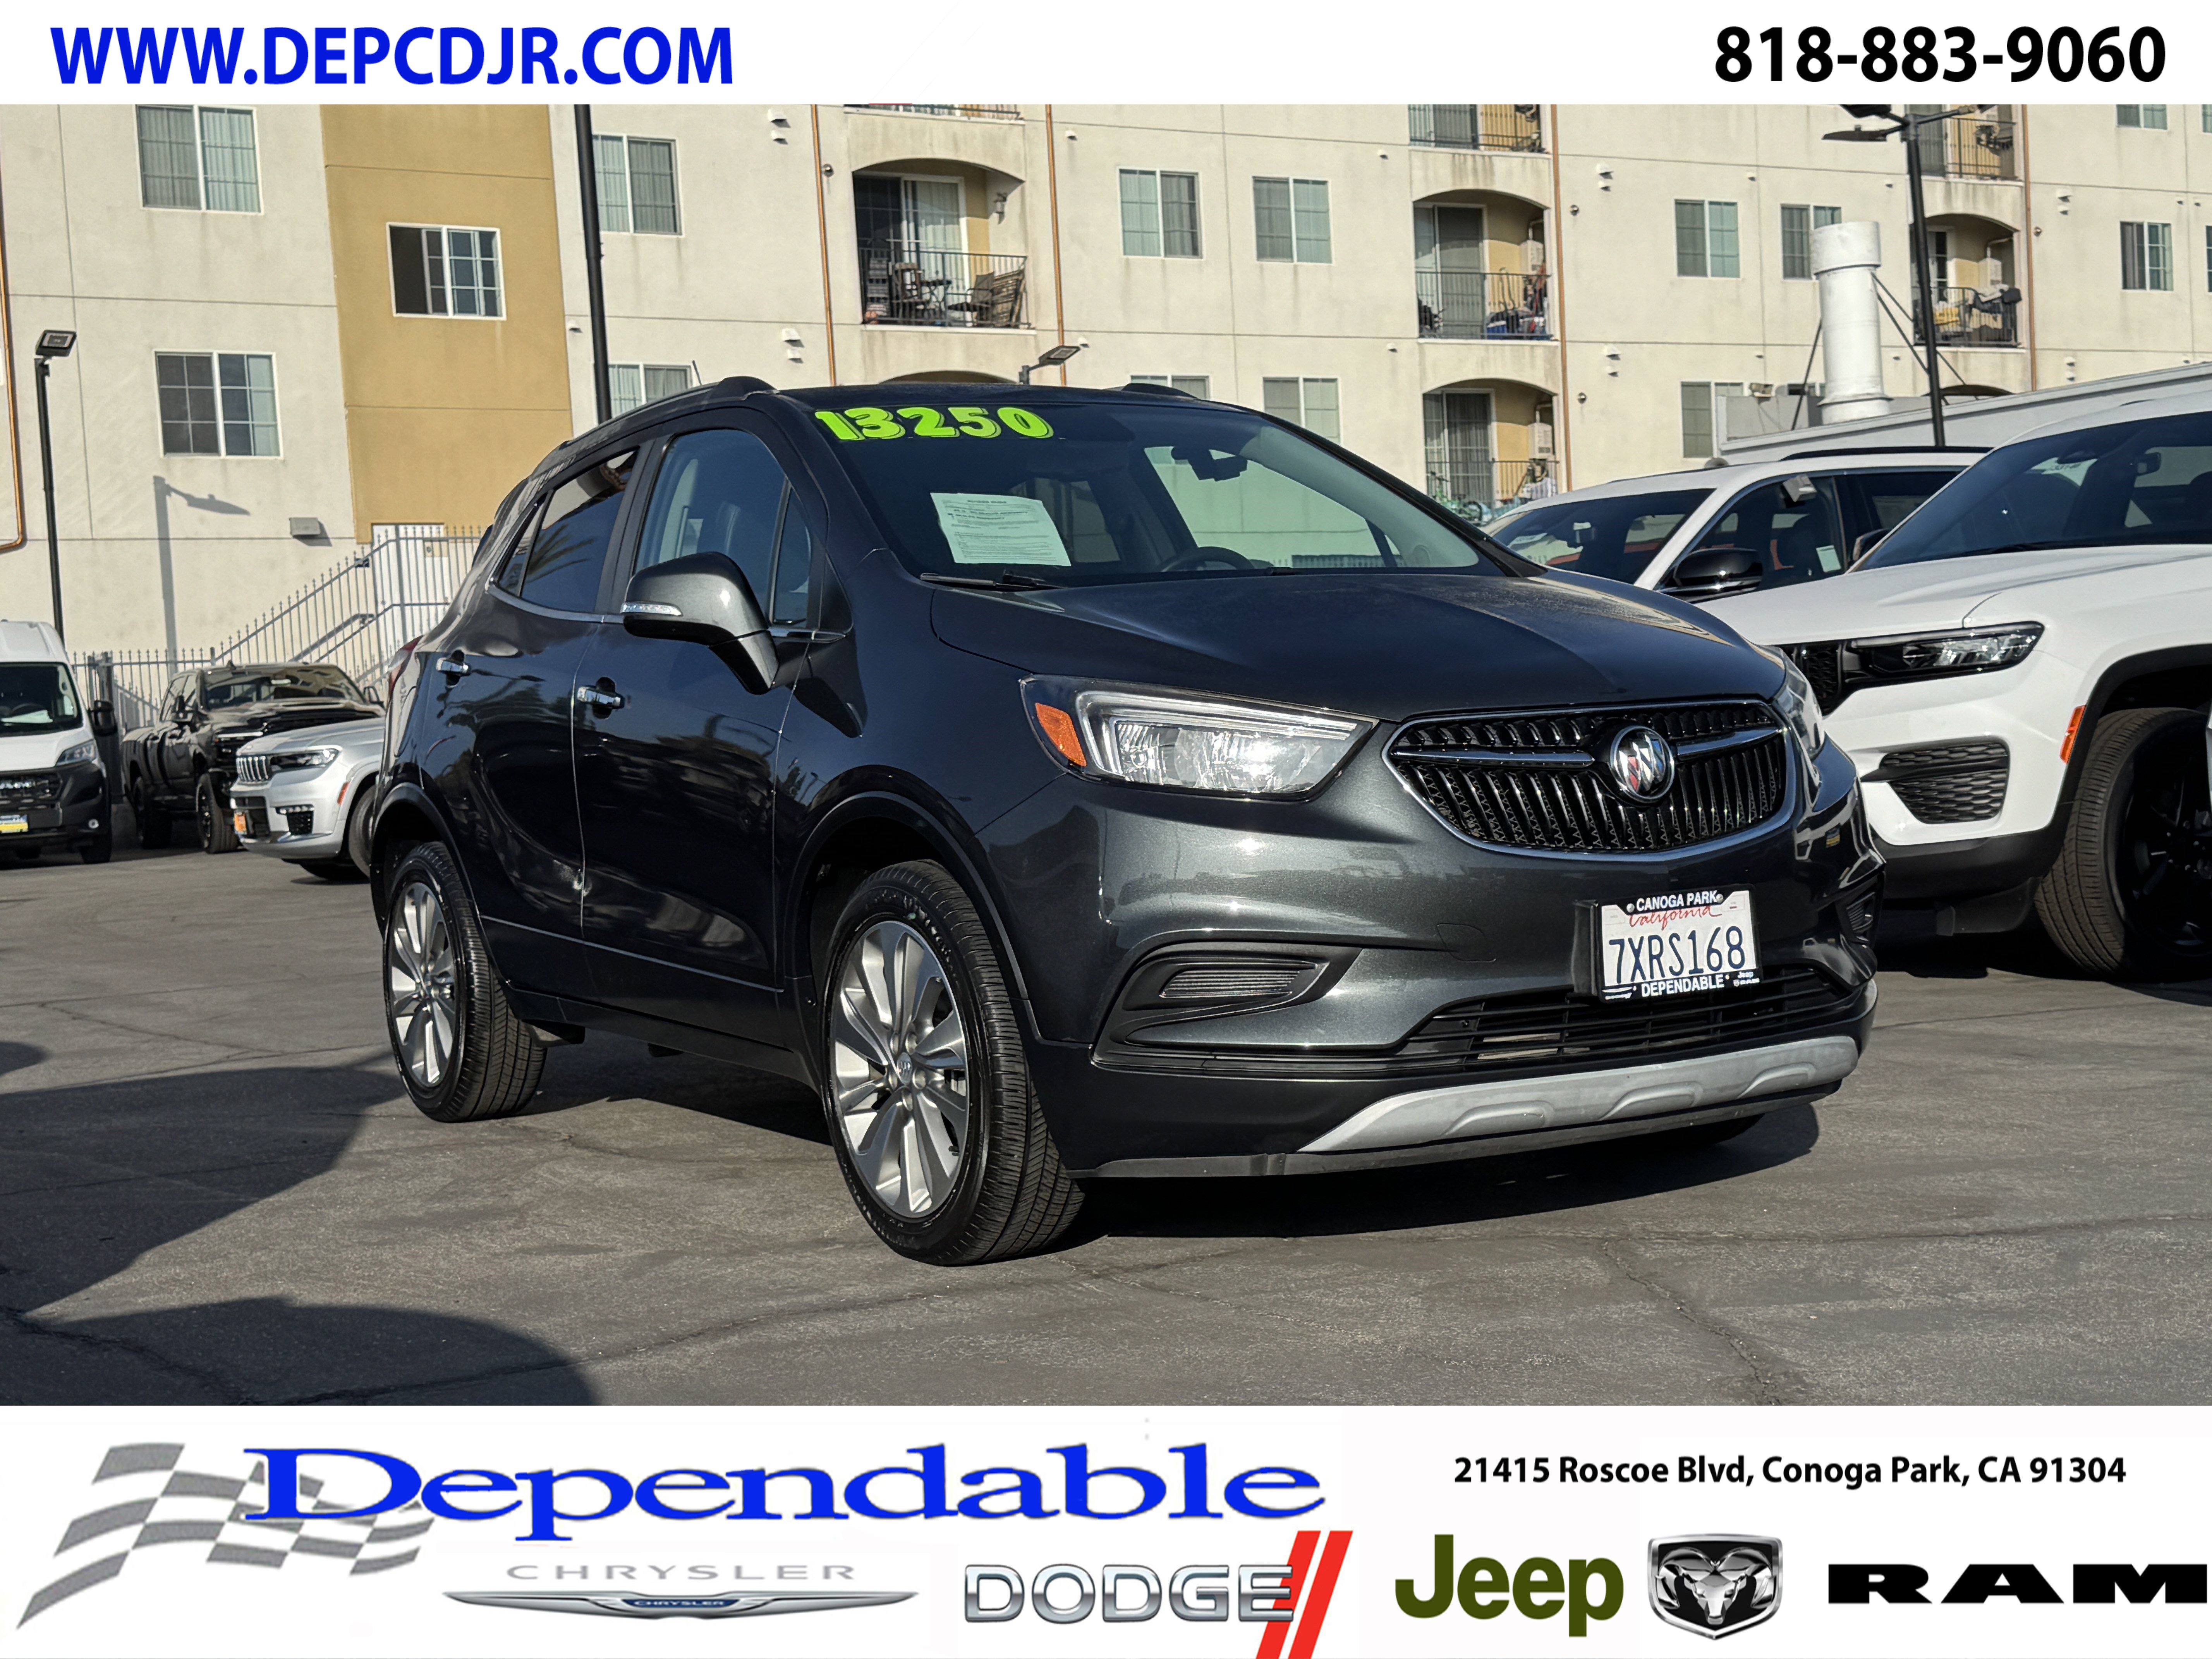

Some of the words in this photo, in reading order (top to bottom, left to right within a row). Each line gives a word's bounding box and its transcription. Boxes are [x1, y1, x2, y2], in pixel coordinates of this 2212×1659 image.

[815, 407, 1054, 440] 13250
[1636, 895, 1685, 911] CANOGA
[1687, 890, 1718, 906] PARK
[1629, 905, 1723, 931] California
[1609, 926, 1745, 984] 7XRS168
[1641, 974, 1725, 998] DEPENDABLE
